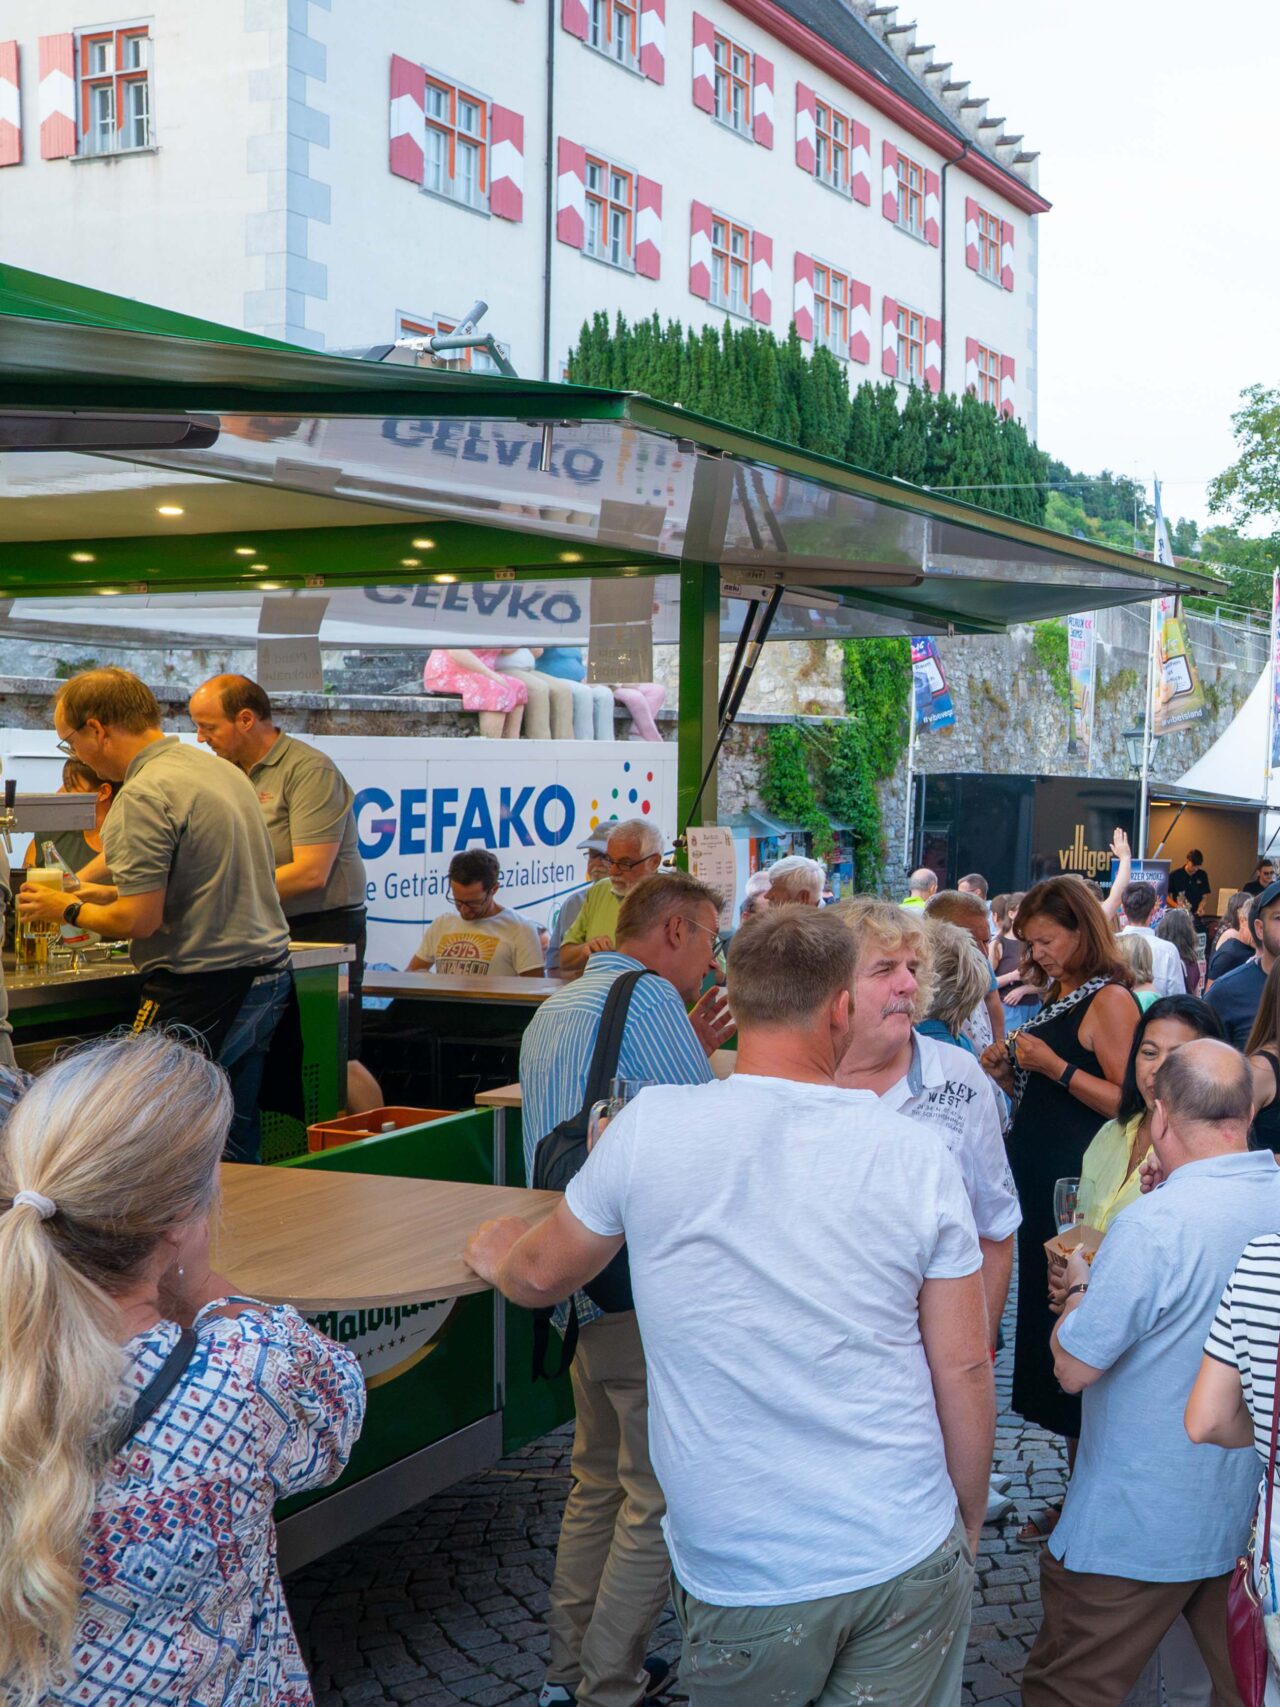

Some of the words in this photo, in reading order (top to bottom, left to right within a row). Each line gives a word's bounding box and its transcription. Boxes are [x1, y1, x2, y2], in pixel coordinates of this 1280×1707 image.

[353, 784, 576, 860] GEFAKO
[1058, 824, 1114, 878] villiger
[443, 943, 476, 957] 1975
[929, 1092, 961, 1108] WEST
[944, 1081, 977, 1103] KEY
